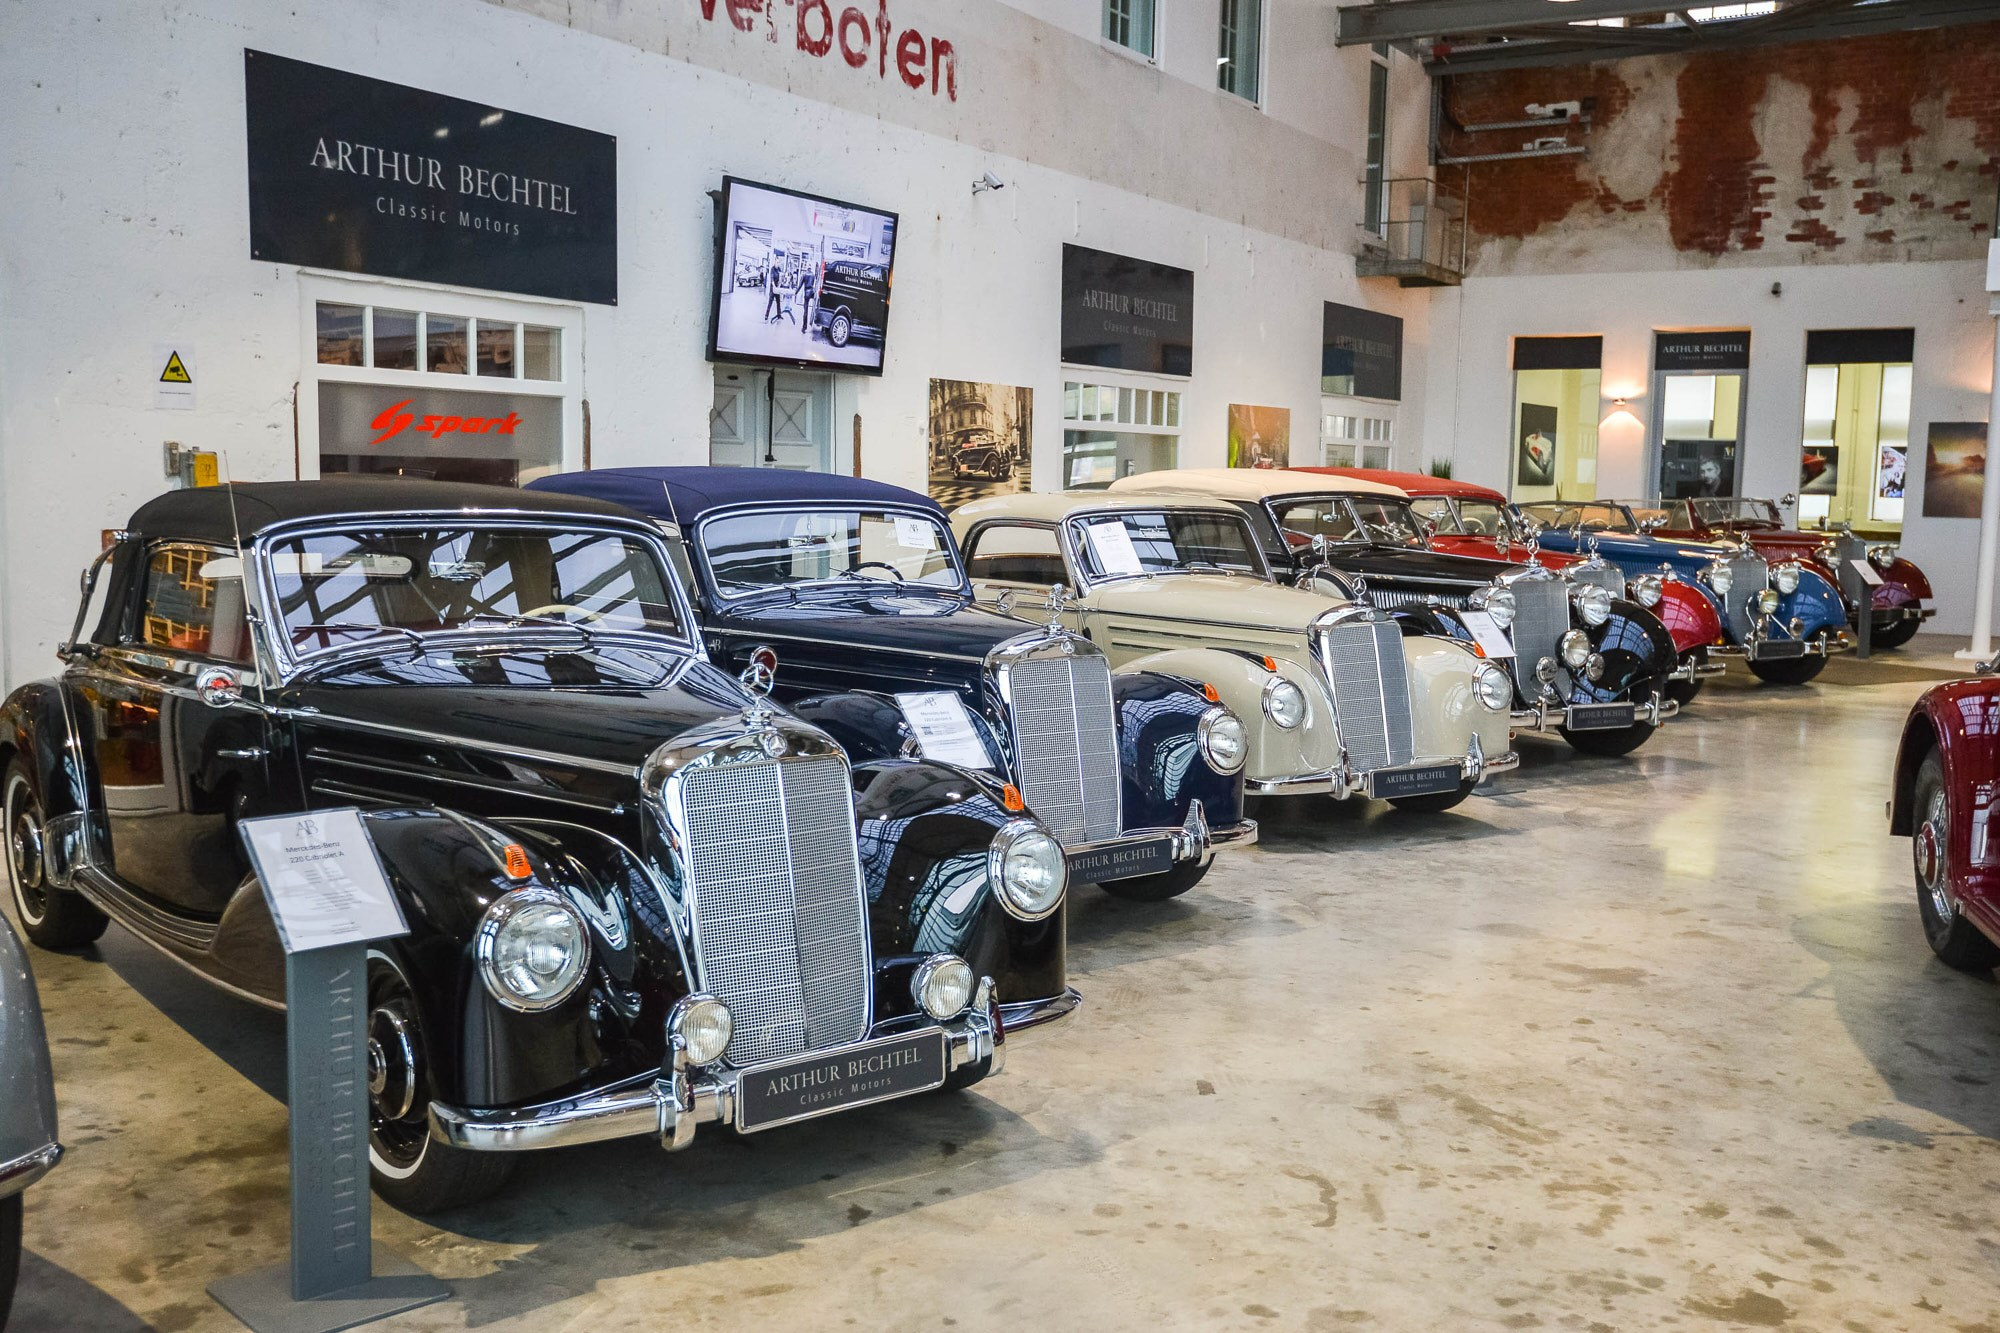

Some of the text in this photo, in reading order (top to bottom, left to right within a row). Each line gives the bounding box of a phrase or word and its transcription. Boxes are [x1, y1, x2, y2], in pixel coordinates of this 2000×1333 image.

[310, 137, 577, 215] ARTHUR BECHTEL
[376, 197, 520, 235] Classic Motors
[835, 265, 859, 277] ARTHUR
[1082, 289, 1178, 322] ARTHUR BECHTEL
[1662, 344, 1744, 353] ARTHUR BECHTEL
[415, 412, 524, 439] spark
[1386, 770, 1447, 784] ARTHUR BECHTEL
[289, 855, 304, 863] 220
[1069, 846, 1158, 871] ARTHUR BECHTEL
[1086, 868, 1112, 880] Classic
[766, 1047, 922, 1097] ARTHUR BECHTEL
[800, 1077, 892, 1105] Classic Motors
